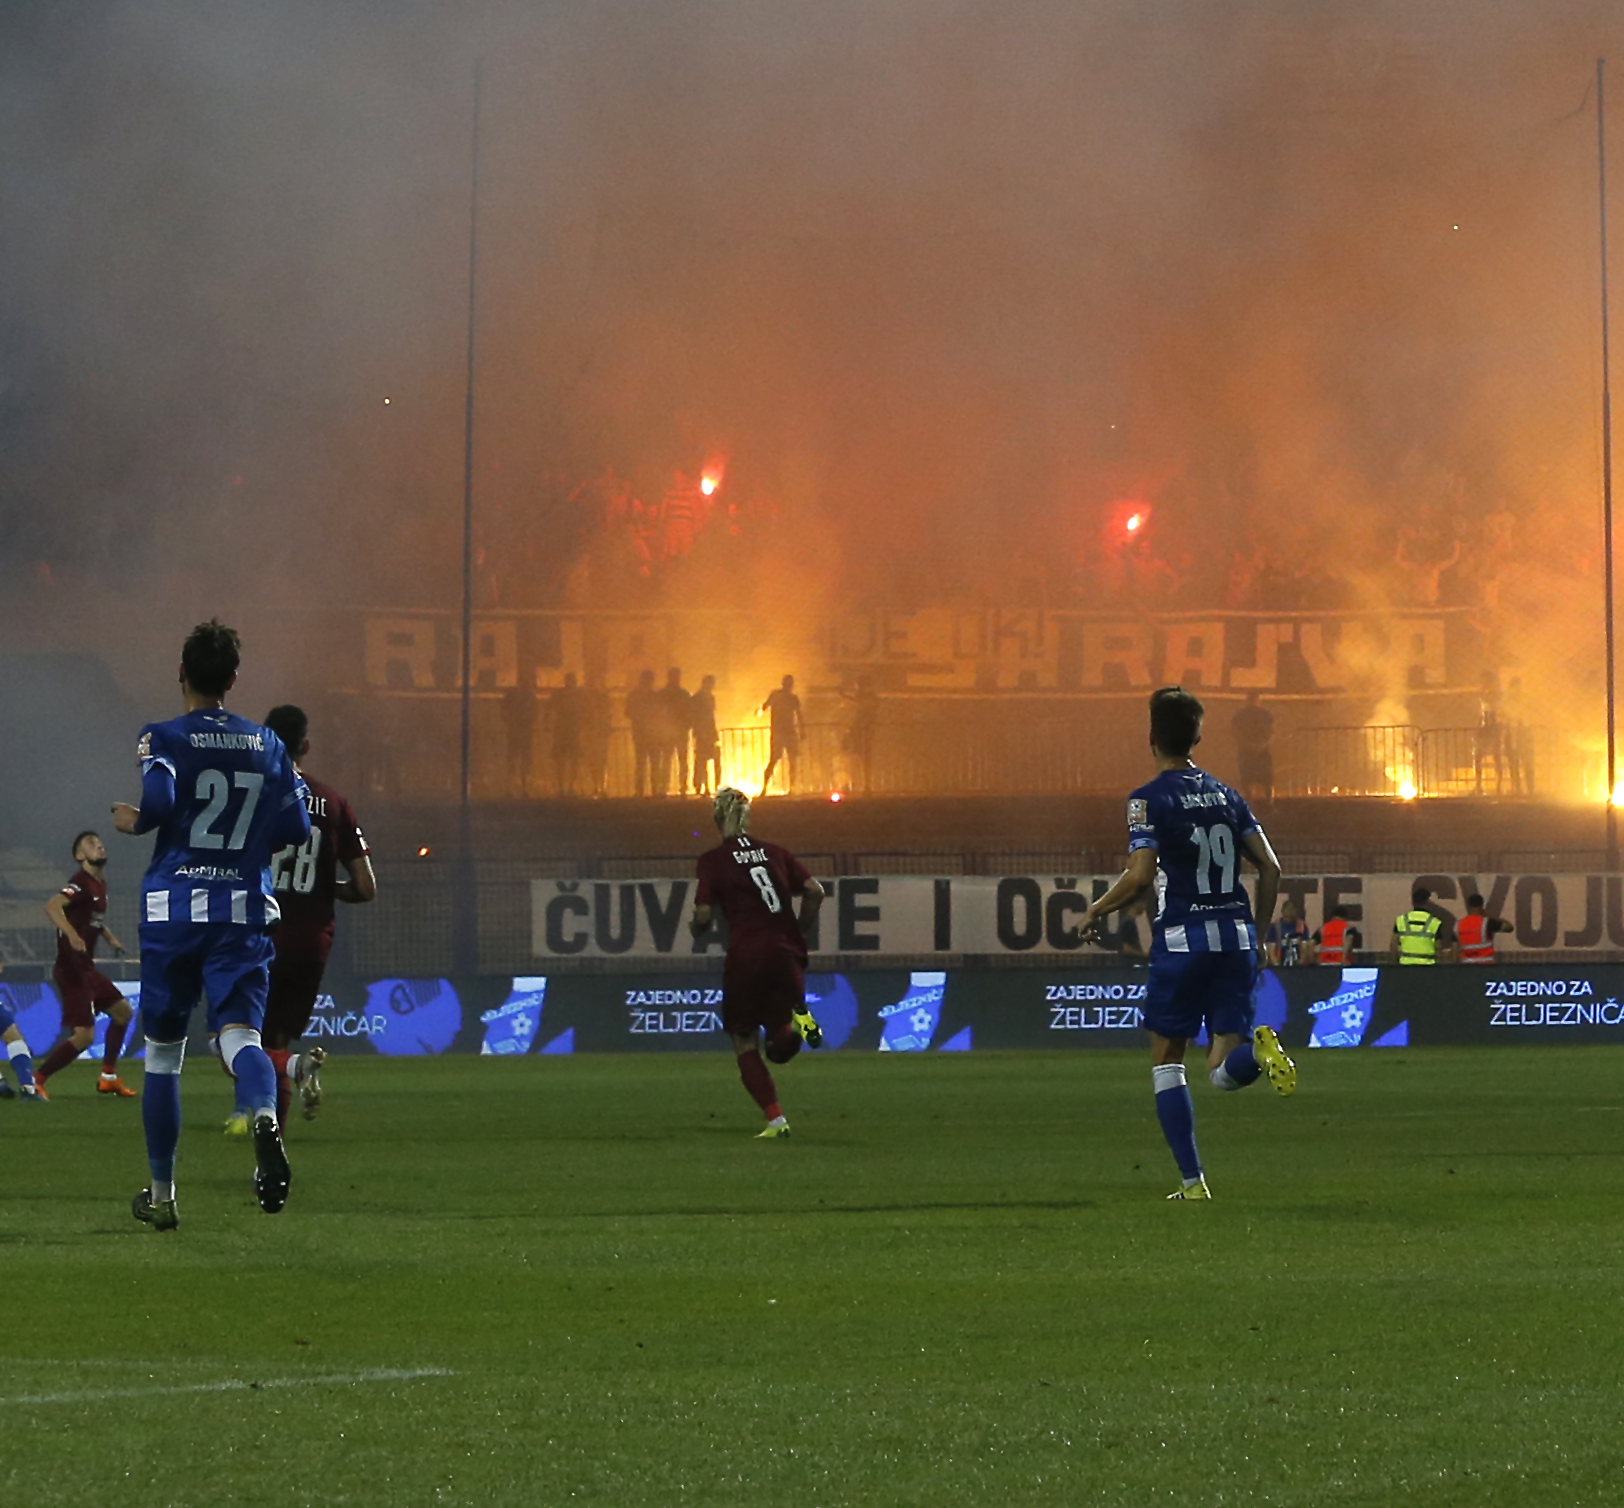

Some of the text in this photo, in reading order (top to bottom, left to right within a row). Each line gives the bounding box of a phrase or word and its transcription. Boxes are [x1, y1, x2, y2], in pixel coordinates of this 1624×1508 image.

[189, 768, 264, 851] 27
[1190, 823, 1235, 895] 19
[749, 865, 781, 914] 8
[934, 879, 951, 951] I
[313, 994, 335, 1009] ZA
[625, 990, 699, 1005] ZAJEDNO
[1045, 985, 1124, 1000] ZAJEDNO
[1485, 980, 1593, 997] ZAJEDNO ZA
